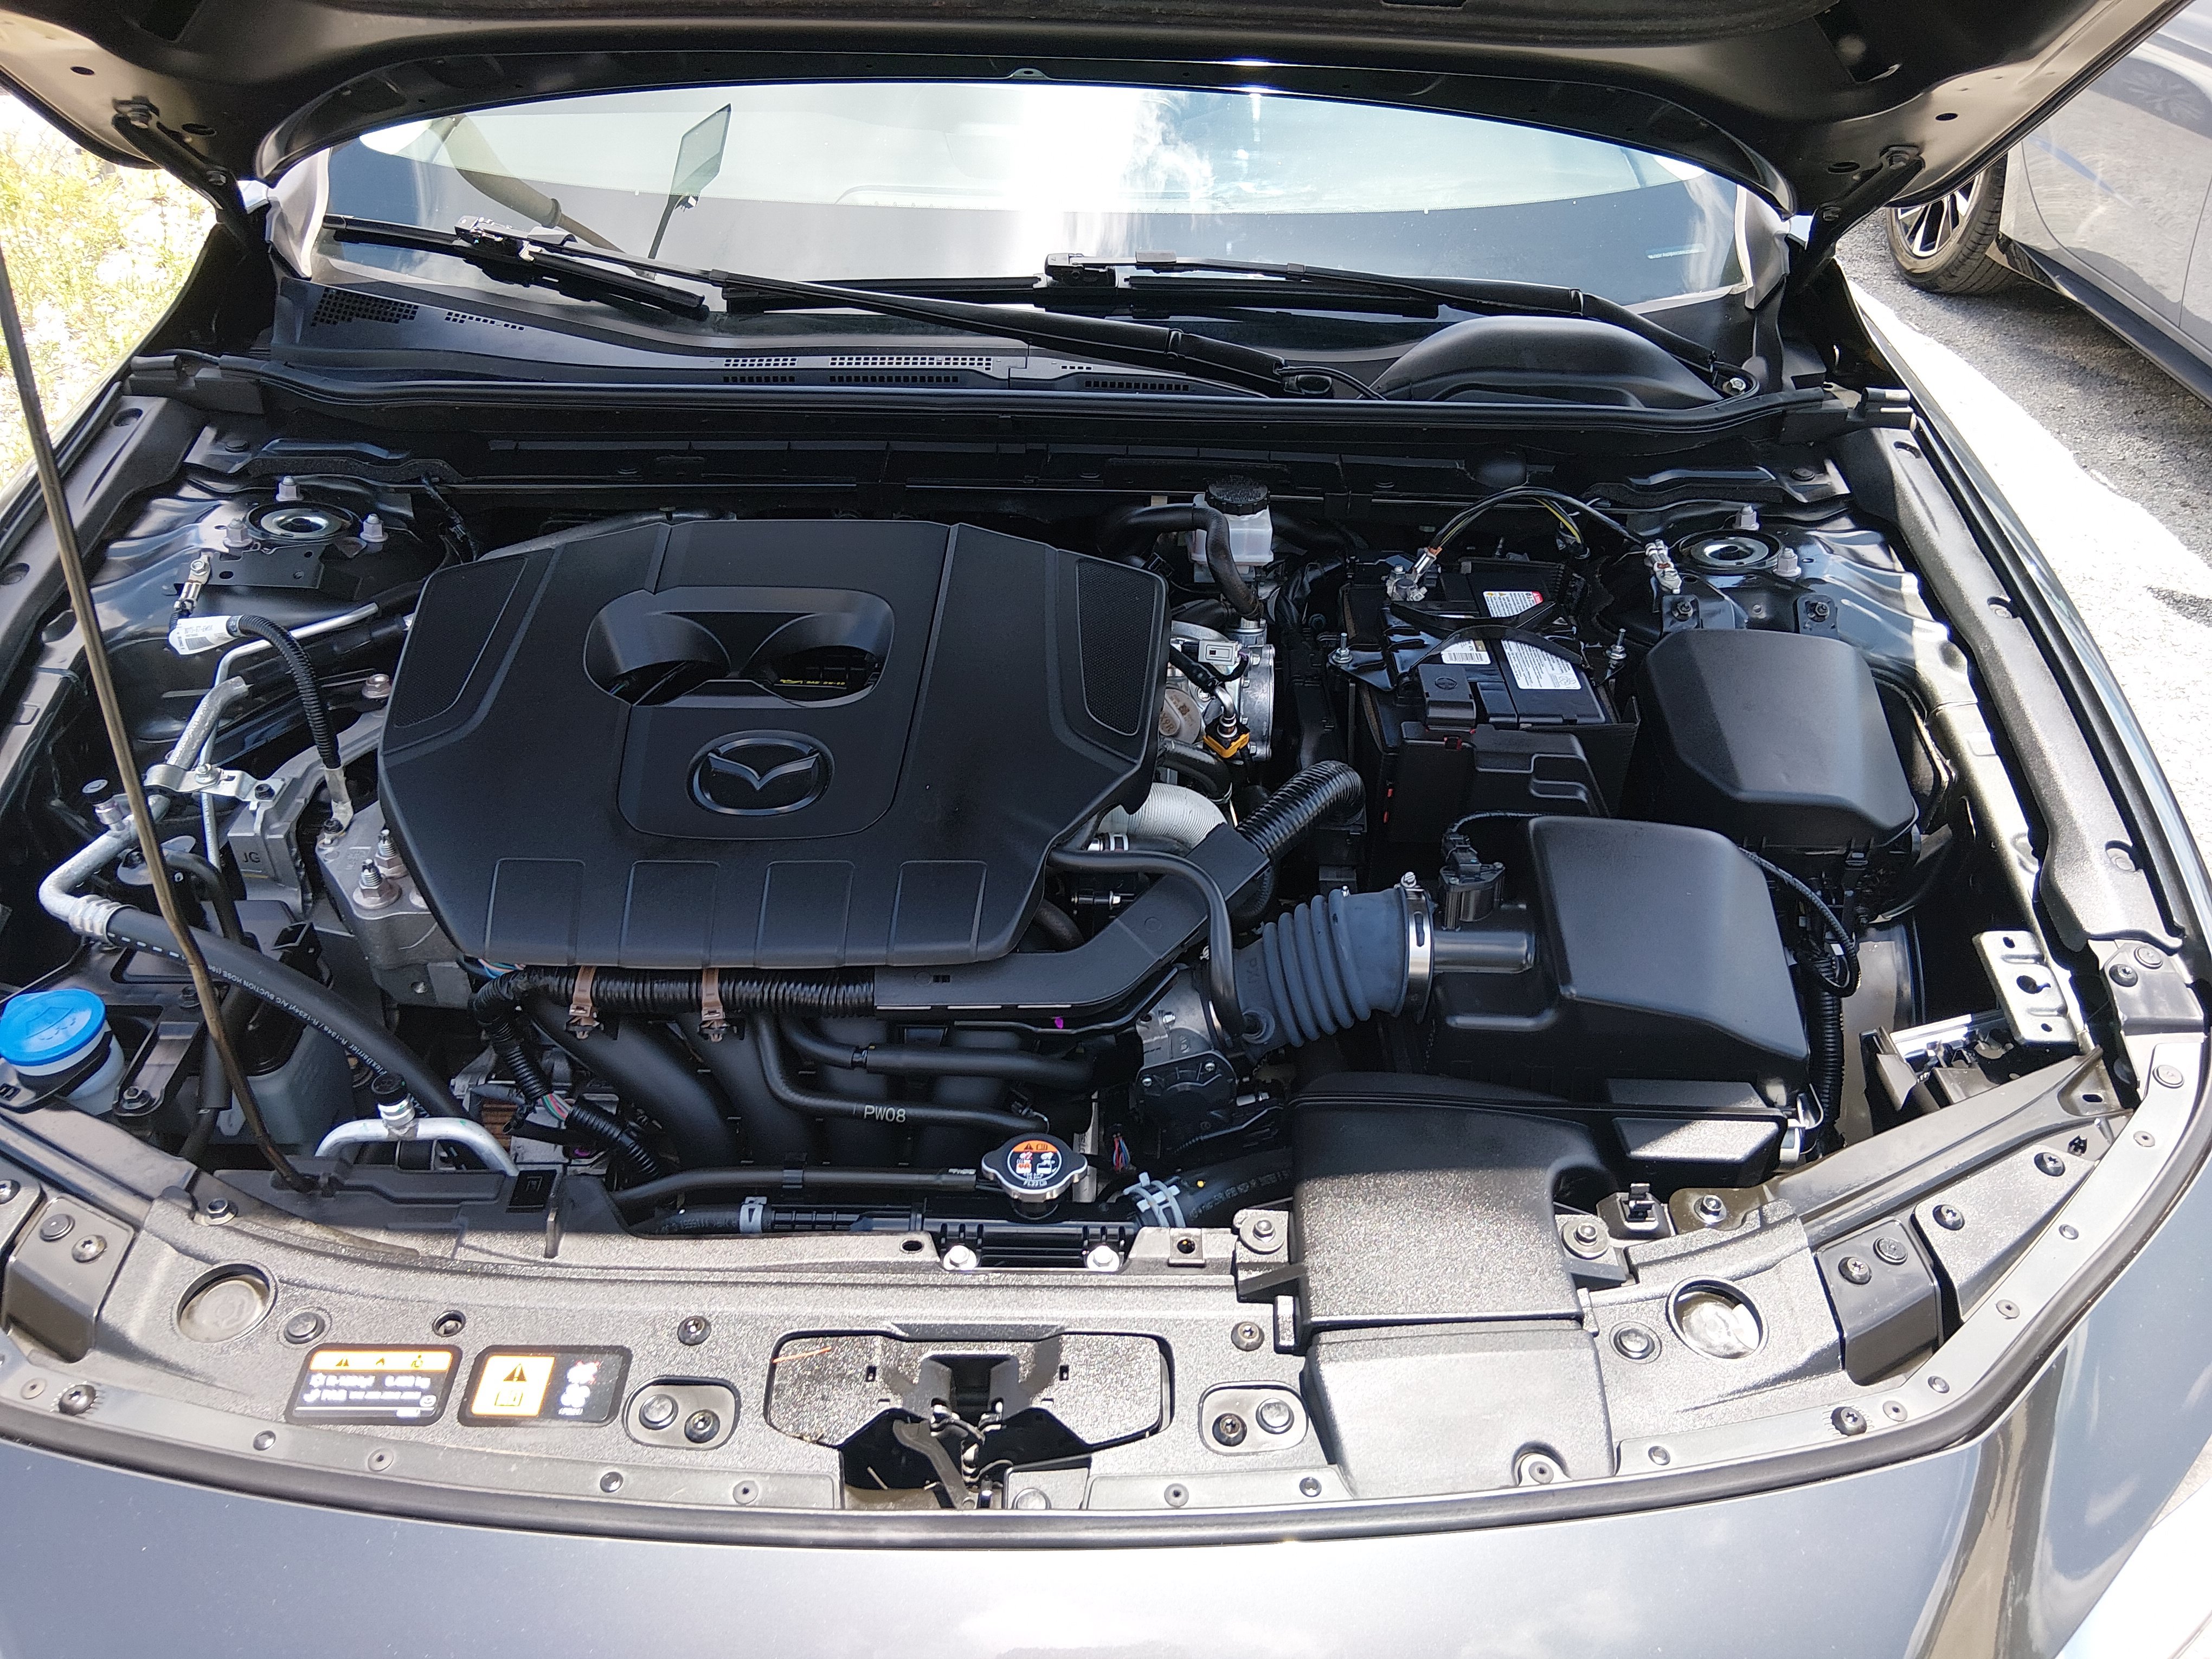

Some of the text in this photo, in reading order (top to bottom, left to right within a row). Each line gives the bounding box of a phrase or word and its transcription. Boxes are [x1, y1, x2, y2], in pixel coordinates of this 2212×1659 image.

[242, 851, 261, 863] JG
[222, 970, 242, 983] HOSE
[243, 980, 275, 1000] SUCTION
[864, 1104, 906, 1123] PW08
